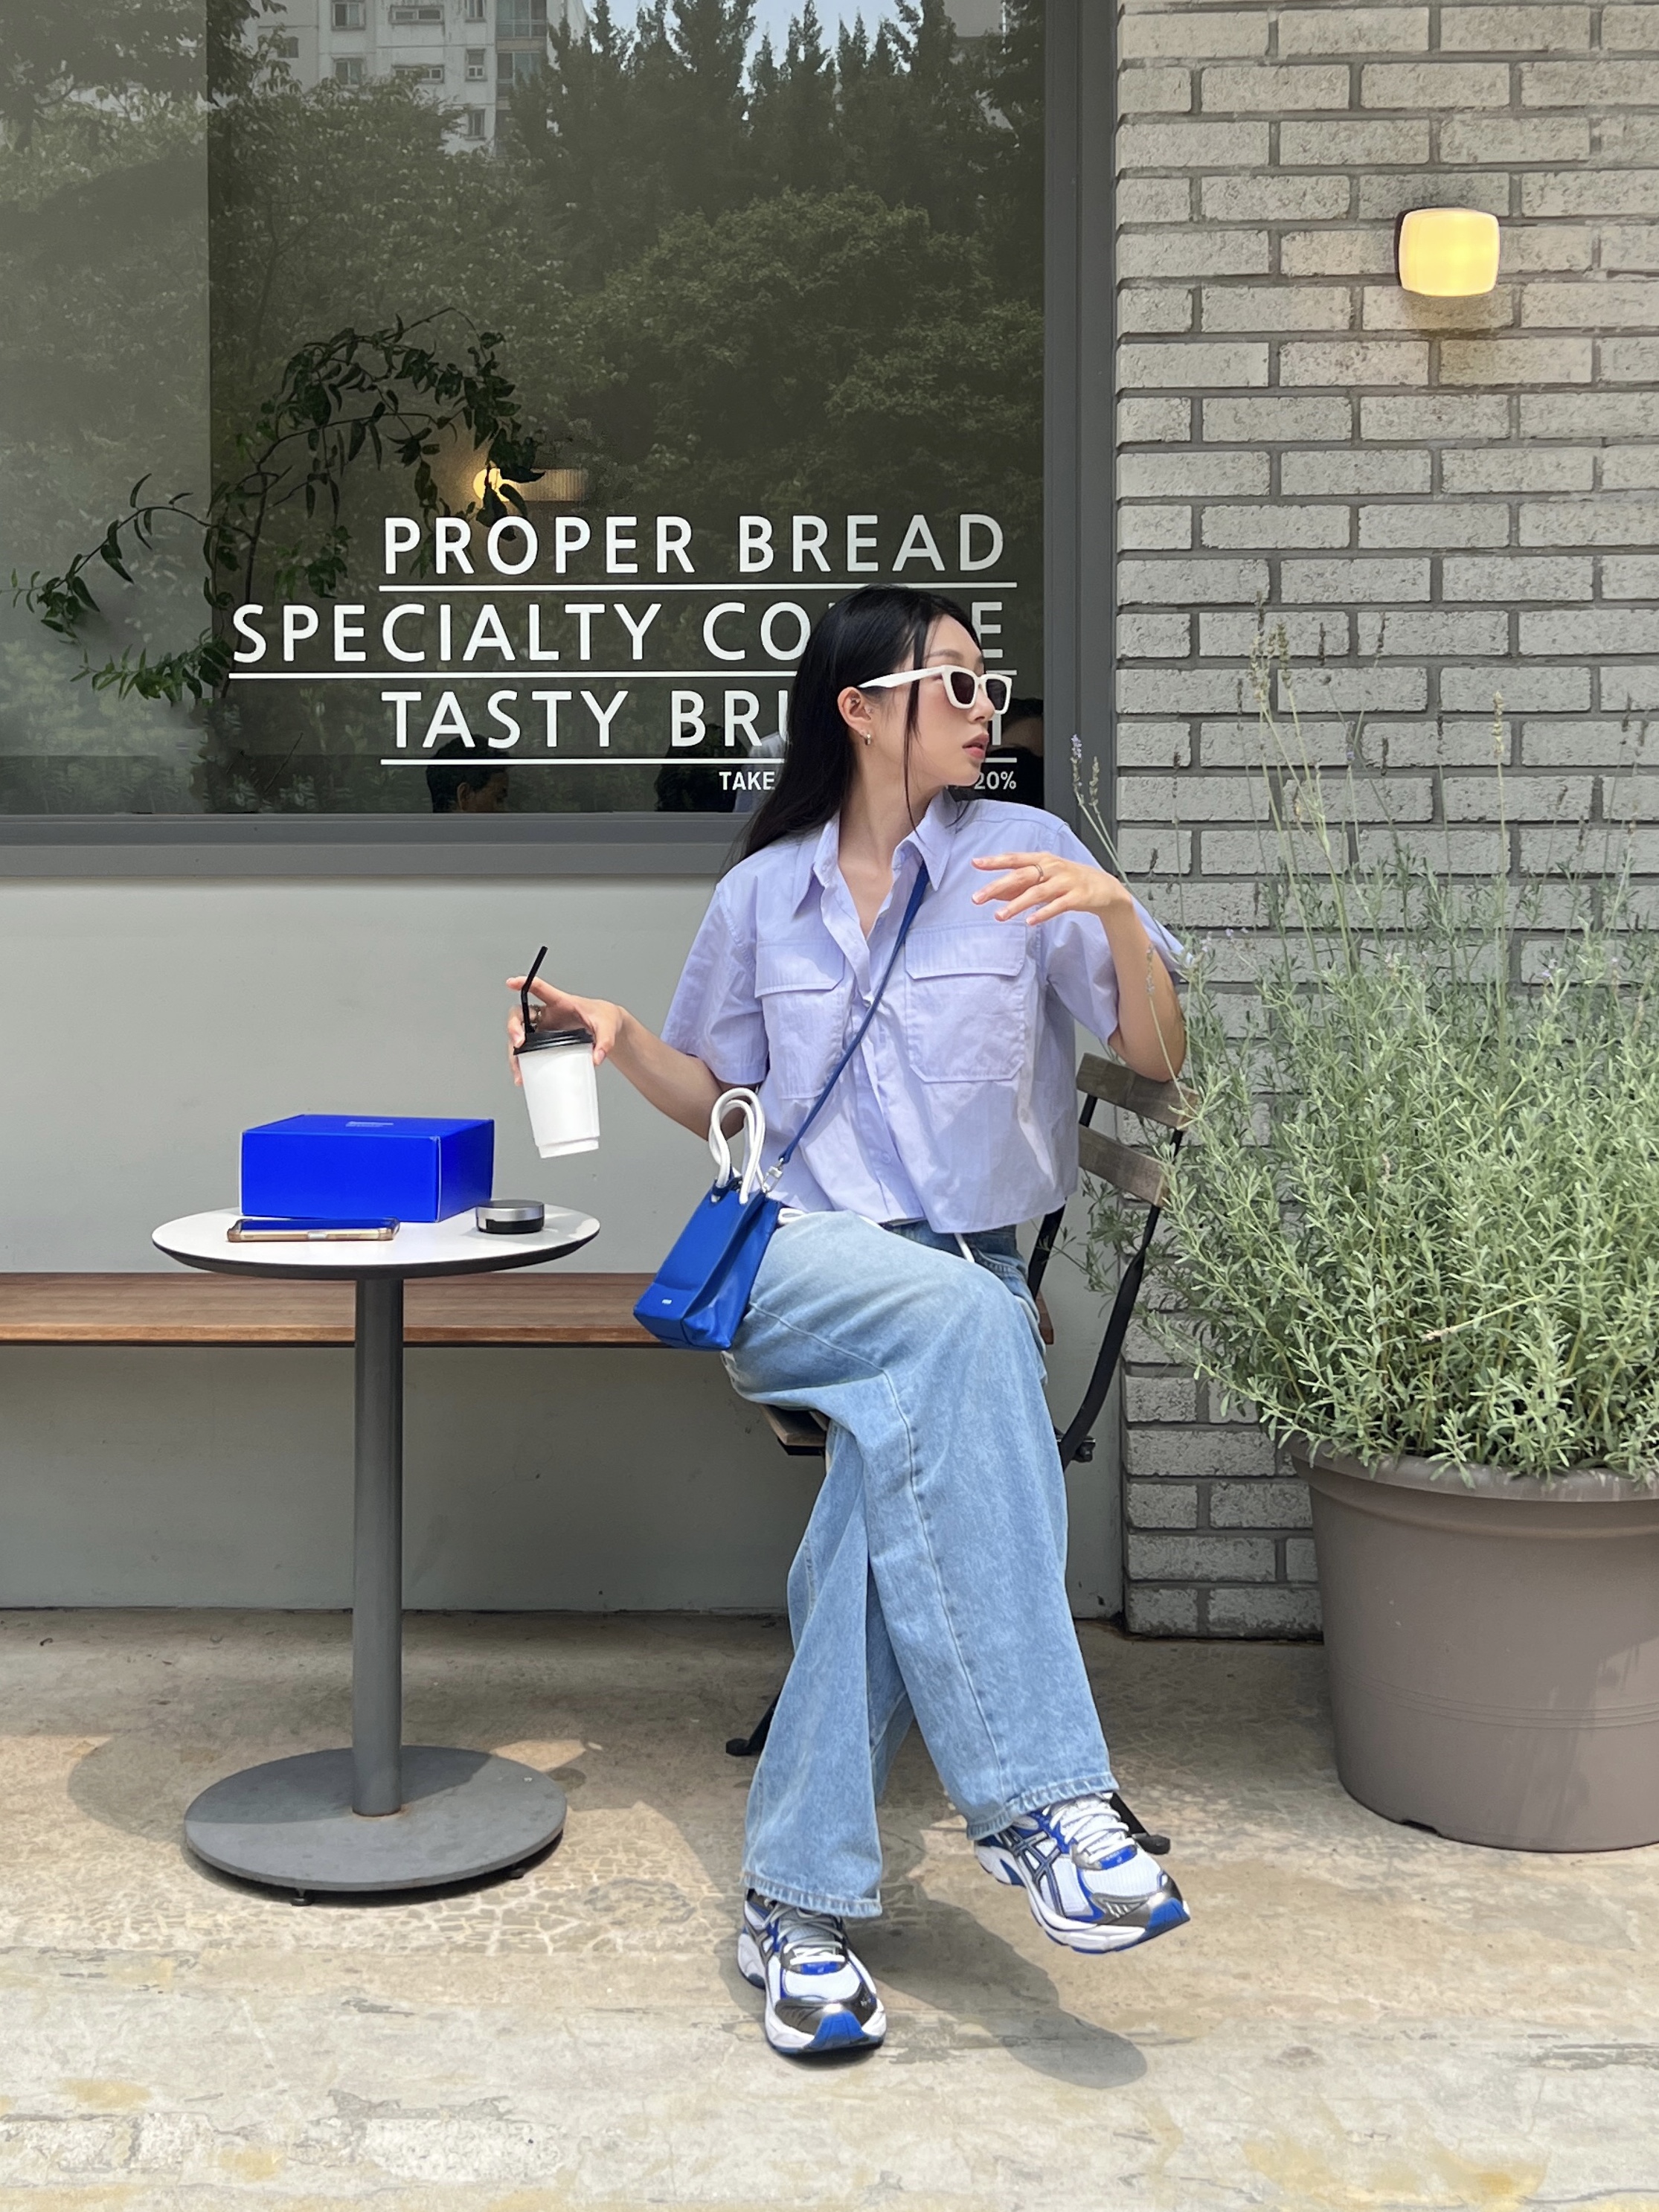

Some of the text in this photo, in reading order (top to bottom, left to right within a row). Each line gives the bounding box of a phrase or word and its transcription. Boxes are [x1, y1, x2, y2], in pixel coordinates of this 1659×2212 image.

[385, 514, 1003, 575] PROPER BREAD
[233, 601, 1003, 663] SPECIALTY COE
[381, 690, 629, 748] TASTY
[719, 771, 1016, 790] TAKE 20%
